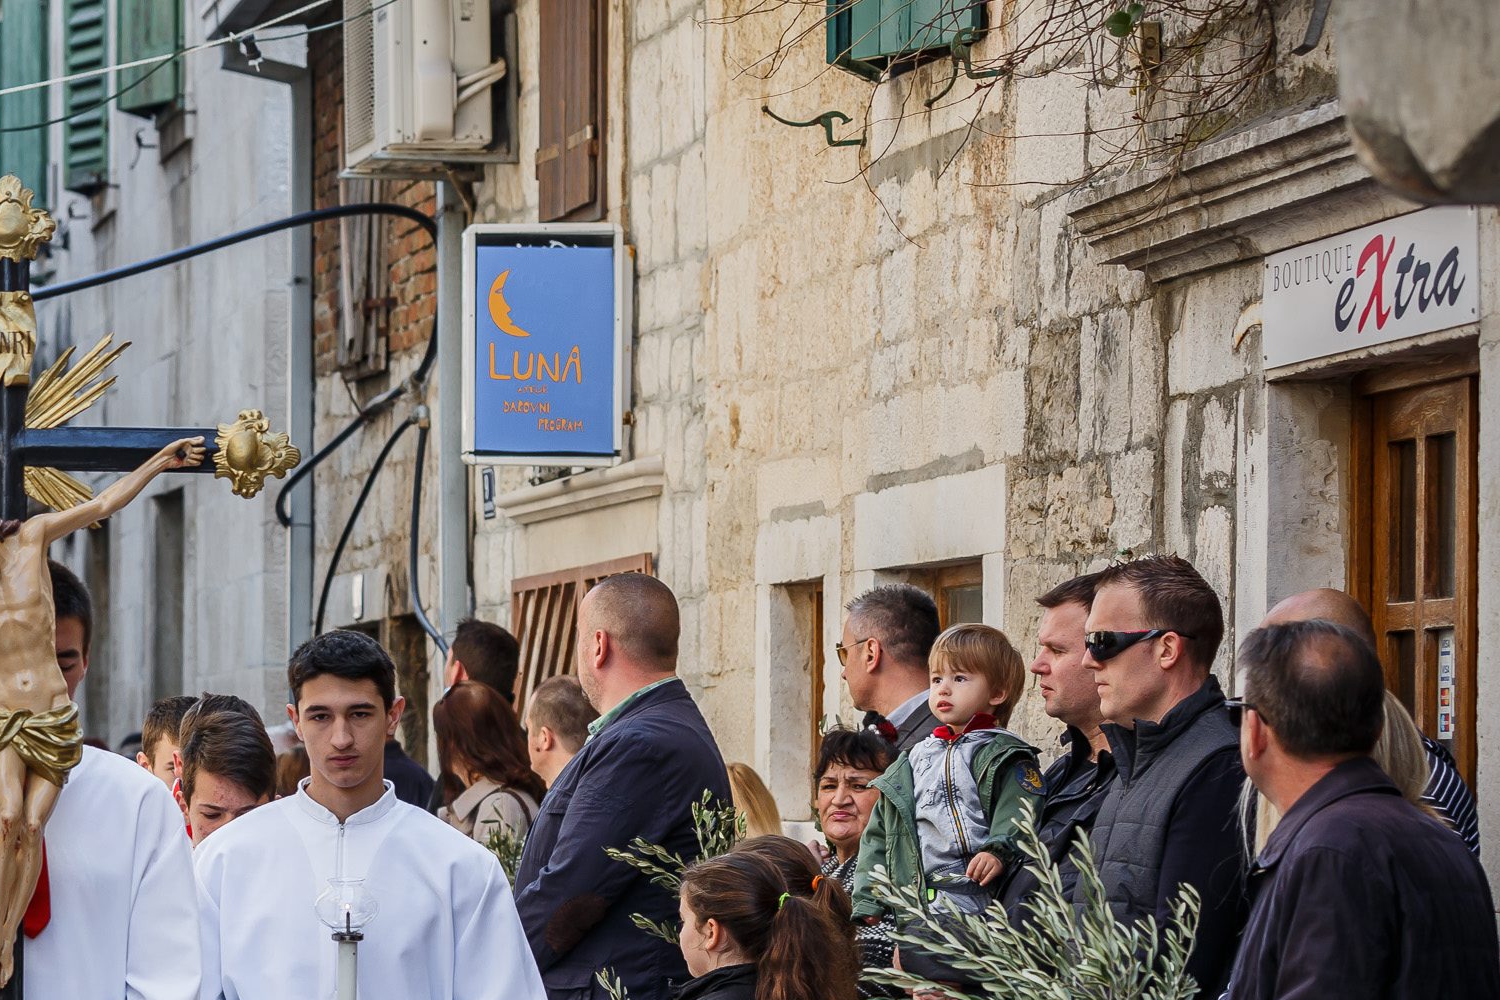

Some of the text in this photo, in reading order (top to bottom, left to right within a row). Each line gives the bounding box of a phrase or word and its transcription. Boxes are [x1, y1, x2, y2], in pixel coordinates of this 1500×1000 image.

[1272, 244, 1353, 292] BOUTIQUE
[1334, 233, 1466, 335] eXtra
[488, 342, 583, 385] LUNA
[503, 400, 550, 414] DAROVNI
[537, 418, 585, 432] PROGRAM
